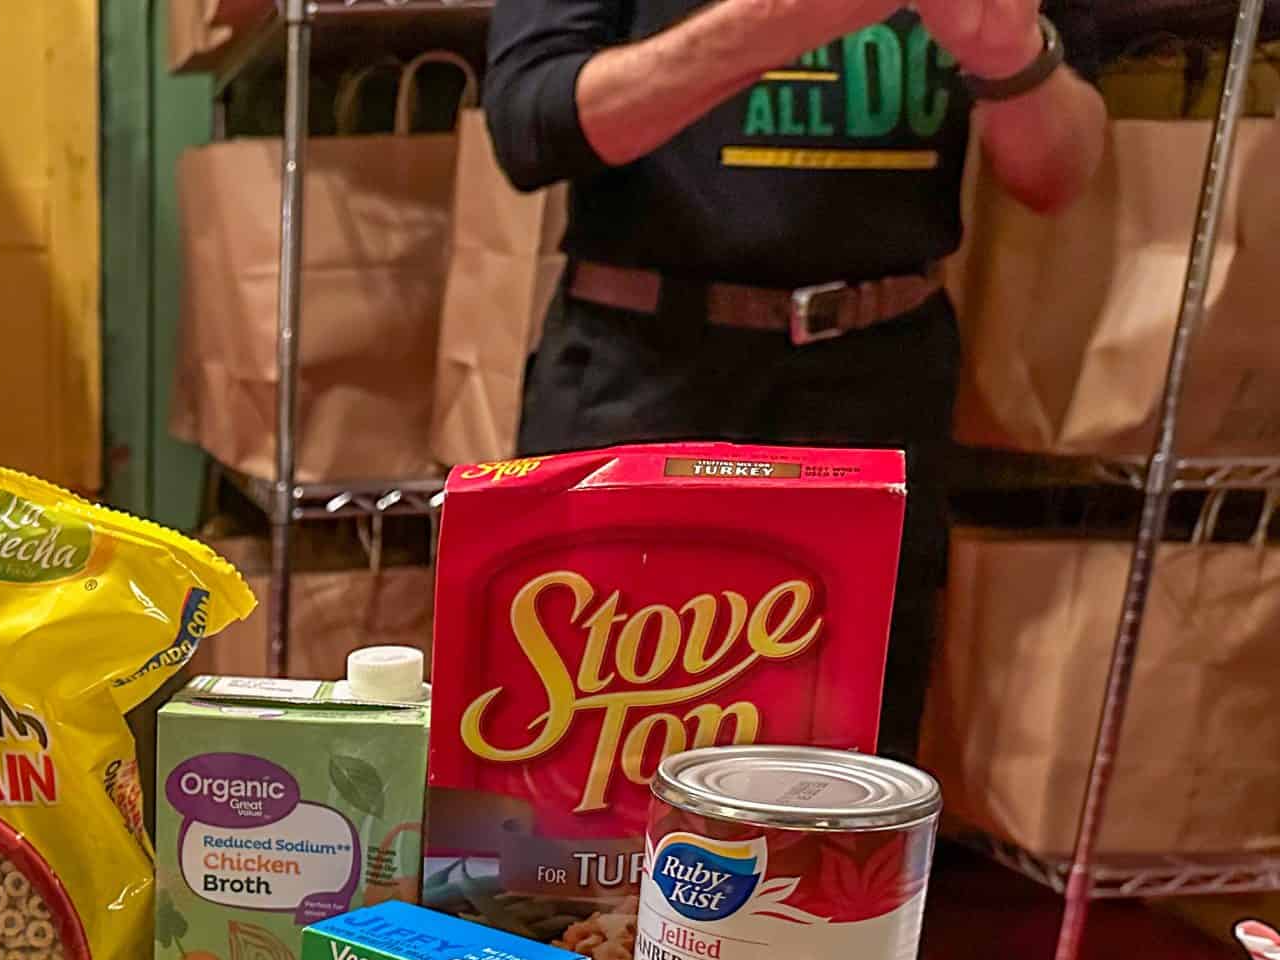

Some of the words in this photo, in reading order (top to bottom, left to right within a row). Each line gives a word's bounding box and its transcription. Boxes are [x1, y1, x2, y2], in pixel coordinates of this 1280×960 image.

[745, 86, 834, 136] ALL
[693, 465, 774, 476] TURKEY
[460, 571, 822, 761] Stove
[180, 772, 285, 802] Organic
[230, 799, 263, 811] Great
[238, 809, 263, 817] Value
[203, 835, 272, 850] Reduced
[203, 852, 301, 875] Chicken
[537, 865, 567, 884] FOR
[661, 855, 730, 892] Ruby
[203, 875, 272, 895] Broth
[669, 882, 727, 911] Kist
[657, 920, 721, 960] Jellied
